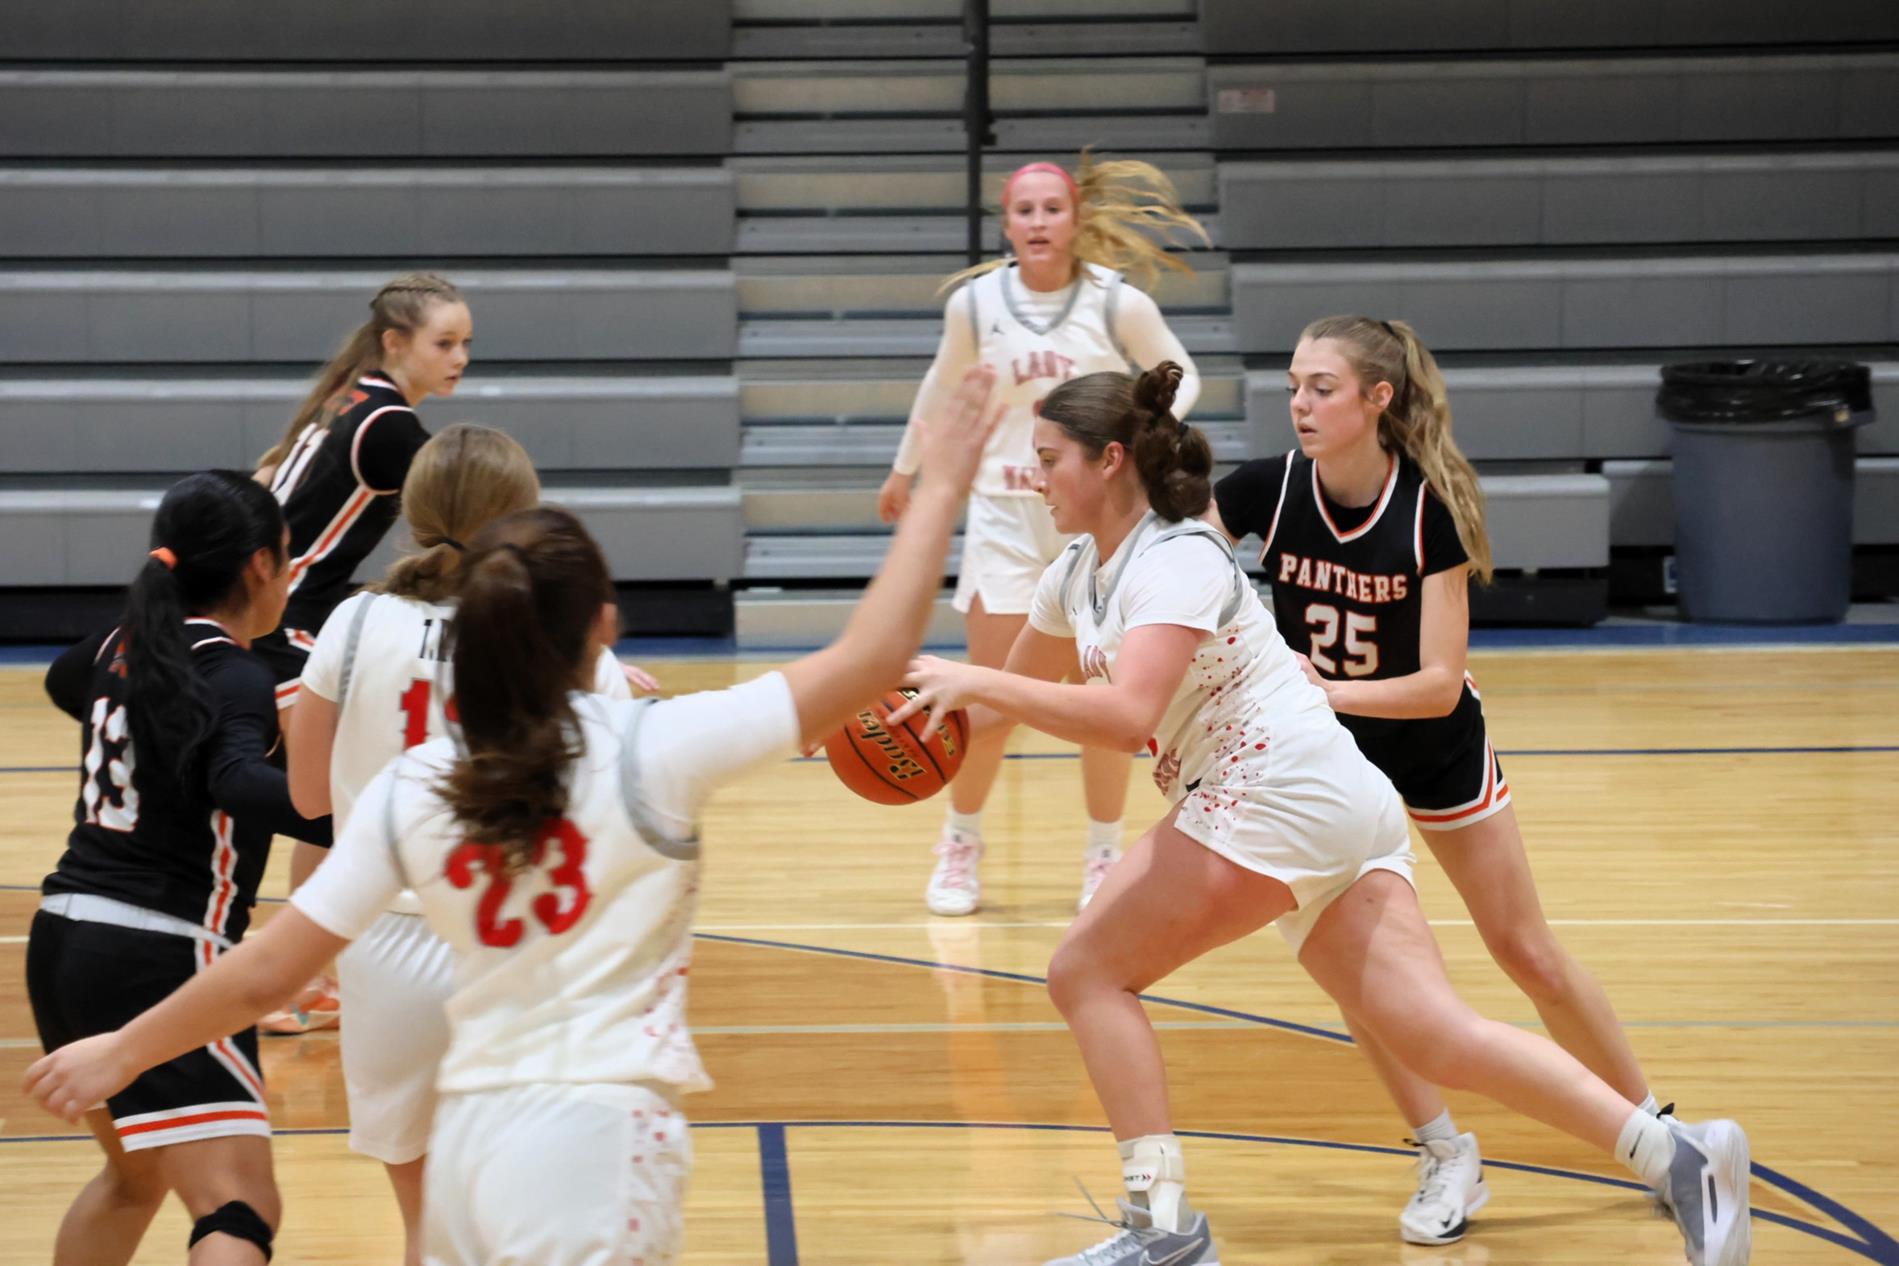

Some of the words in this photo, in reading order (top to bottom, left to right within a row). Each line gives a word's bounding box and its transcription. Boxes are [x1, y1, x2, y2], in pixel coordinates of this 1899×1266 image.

[1278, 552, 1408, 603] PANTHERS
[1304, 602, 1379, 677] 25
[400, 677, 462, 752] 1
[84, 696, 140, 832] 13
[443, 817, 594, 948] 23
